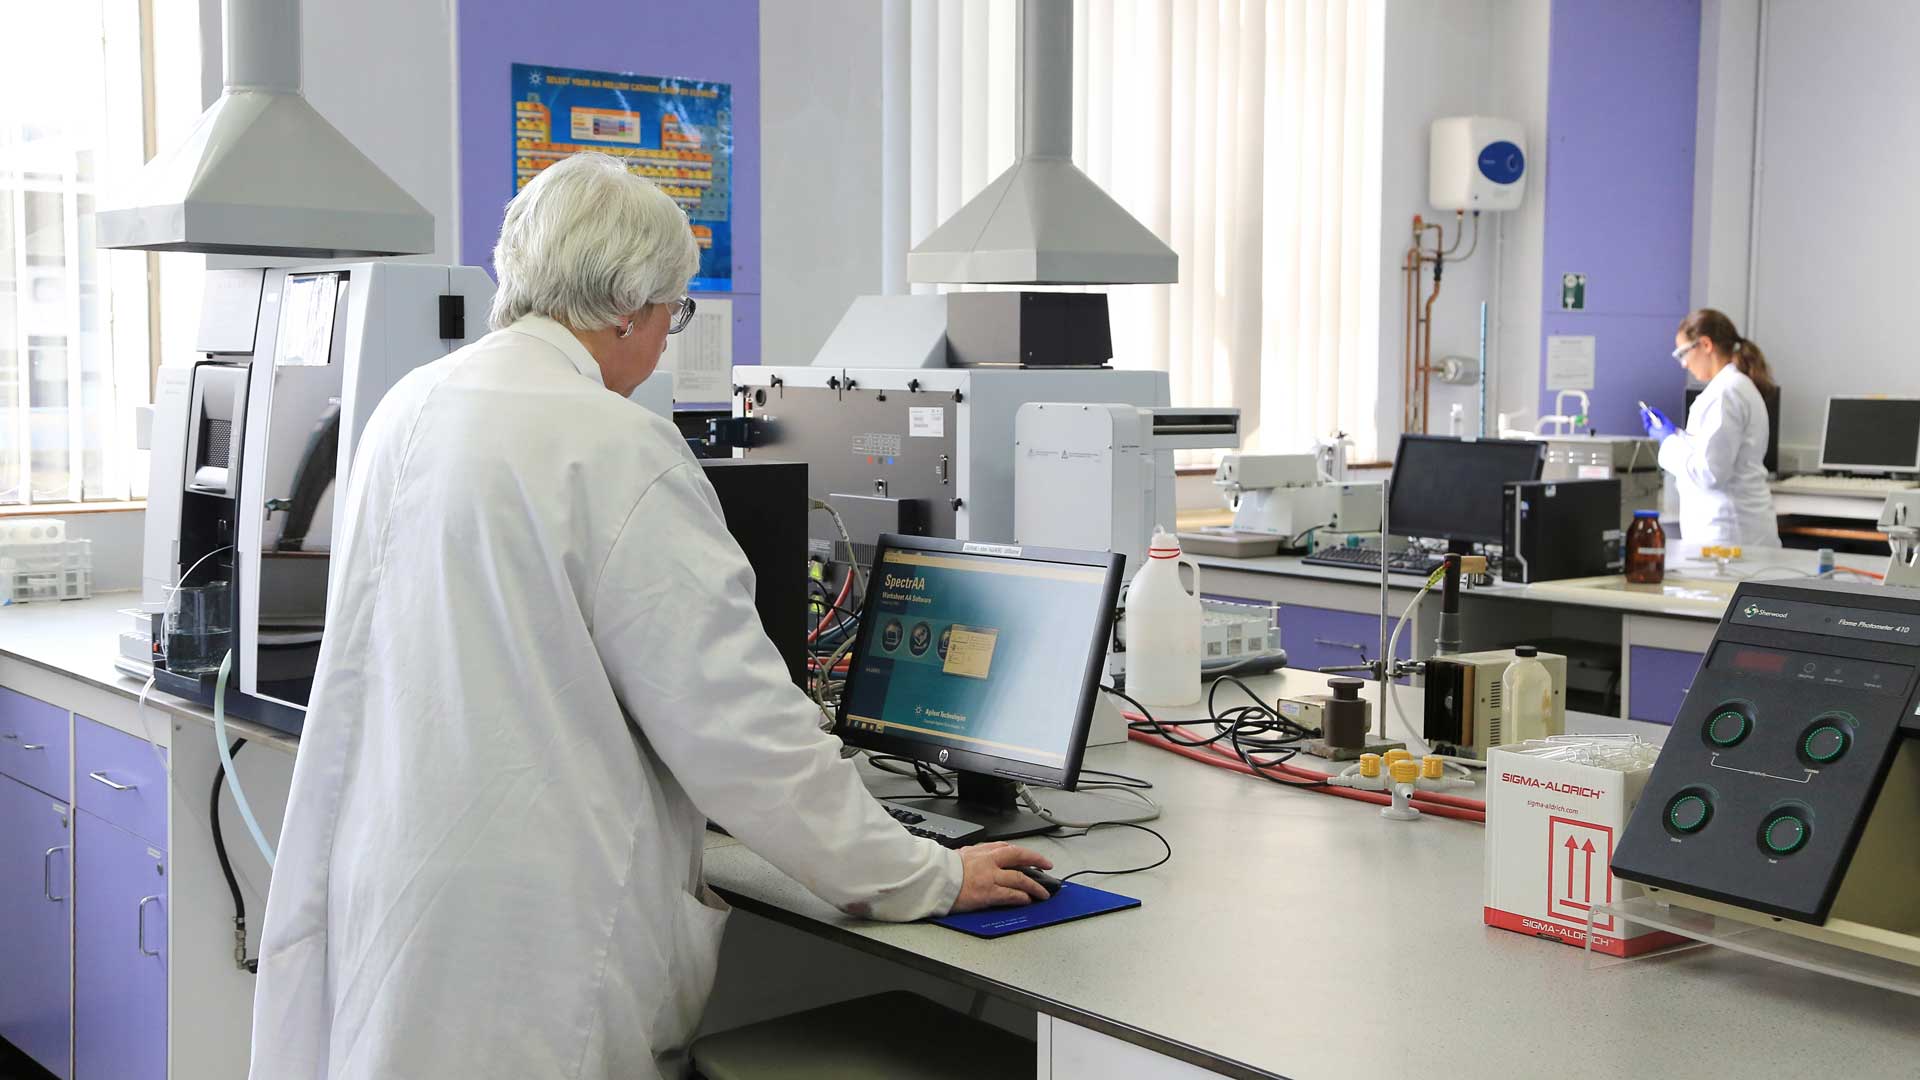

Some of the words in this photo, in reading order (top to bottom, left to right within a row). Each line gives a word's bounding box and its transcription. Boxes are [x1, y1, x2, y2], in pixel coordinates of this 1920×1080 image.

[884, 573, 926, 591] SpectrAA
[1759, 609, 1788, 619] Sherwood
[1838, 618, 1857, 627] Flame
[1857, 621, 1894, 631] Photometer
[925, 708, 940, 718] Agilent
[939, 710, 967, 722] Technologies
[1527, 800, 1579, 815] sigma-aldrich.com
